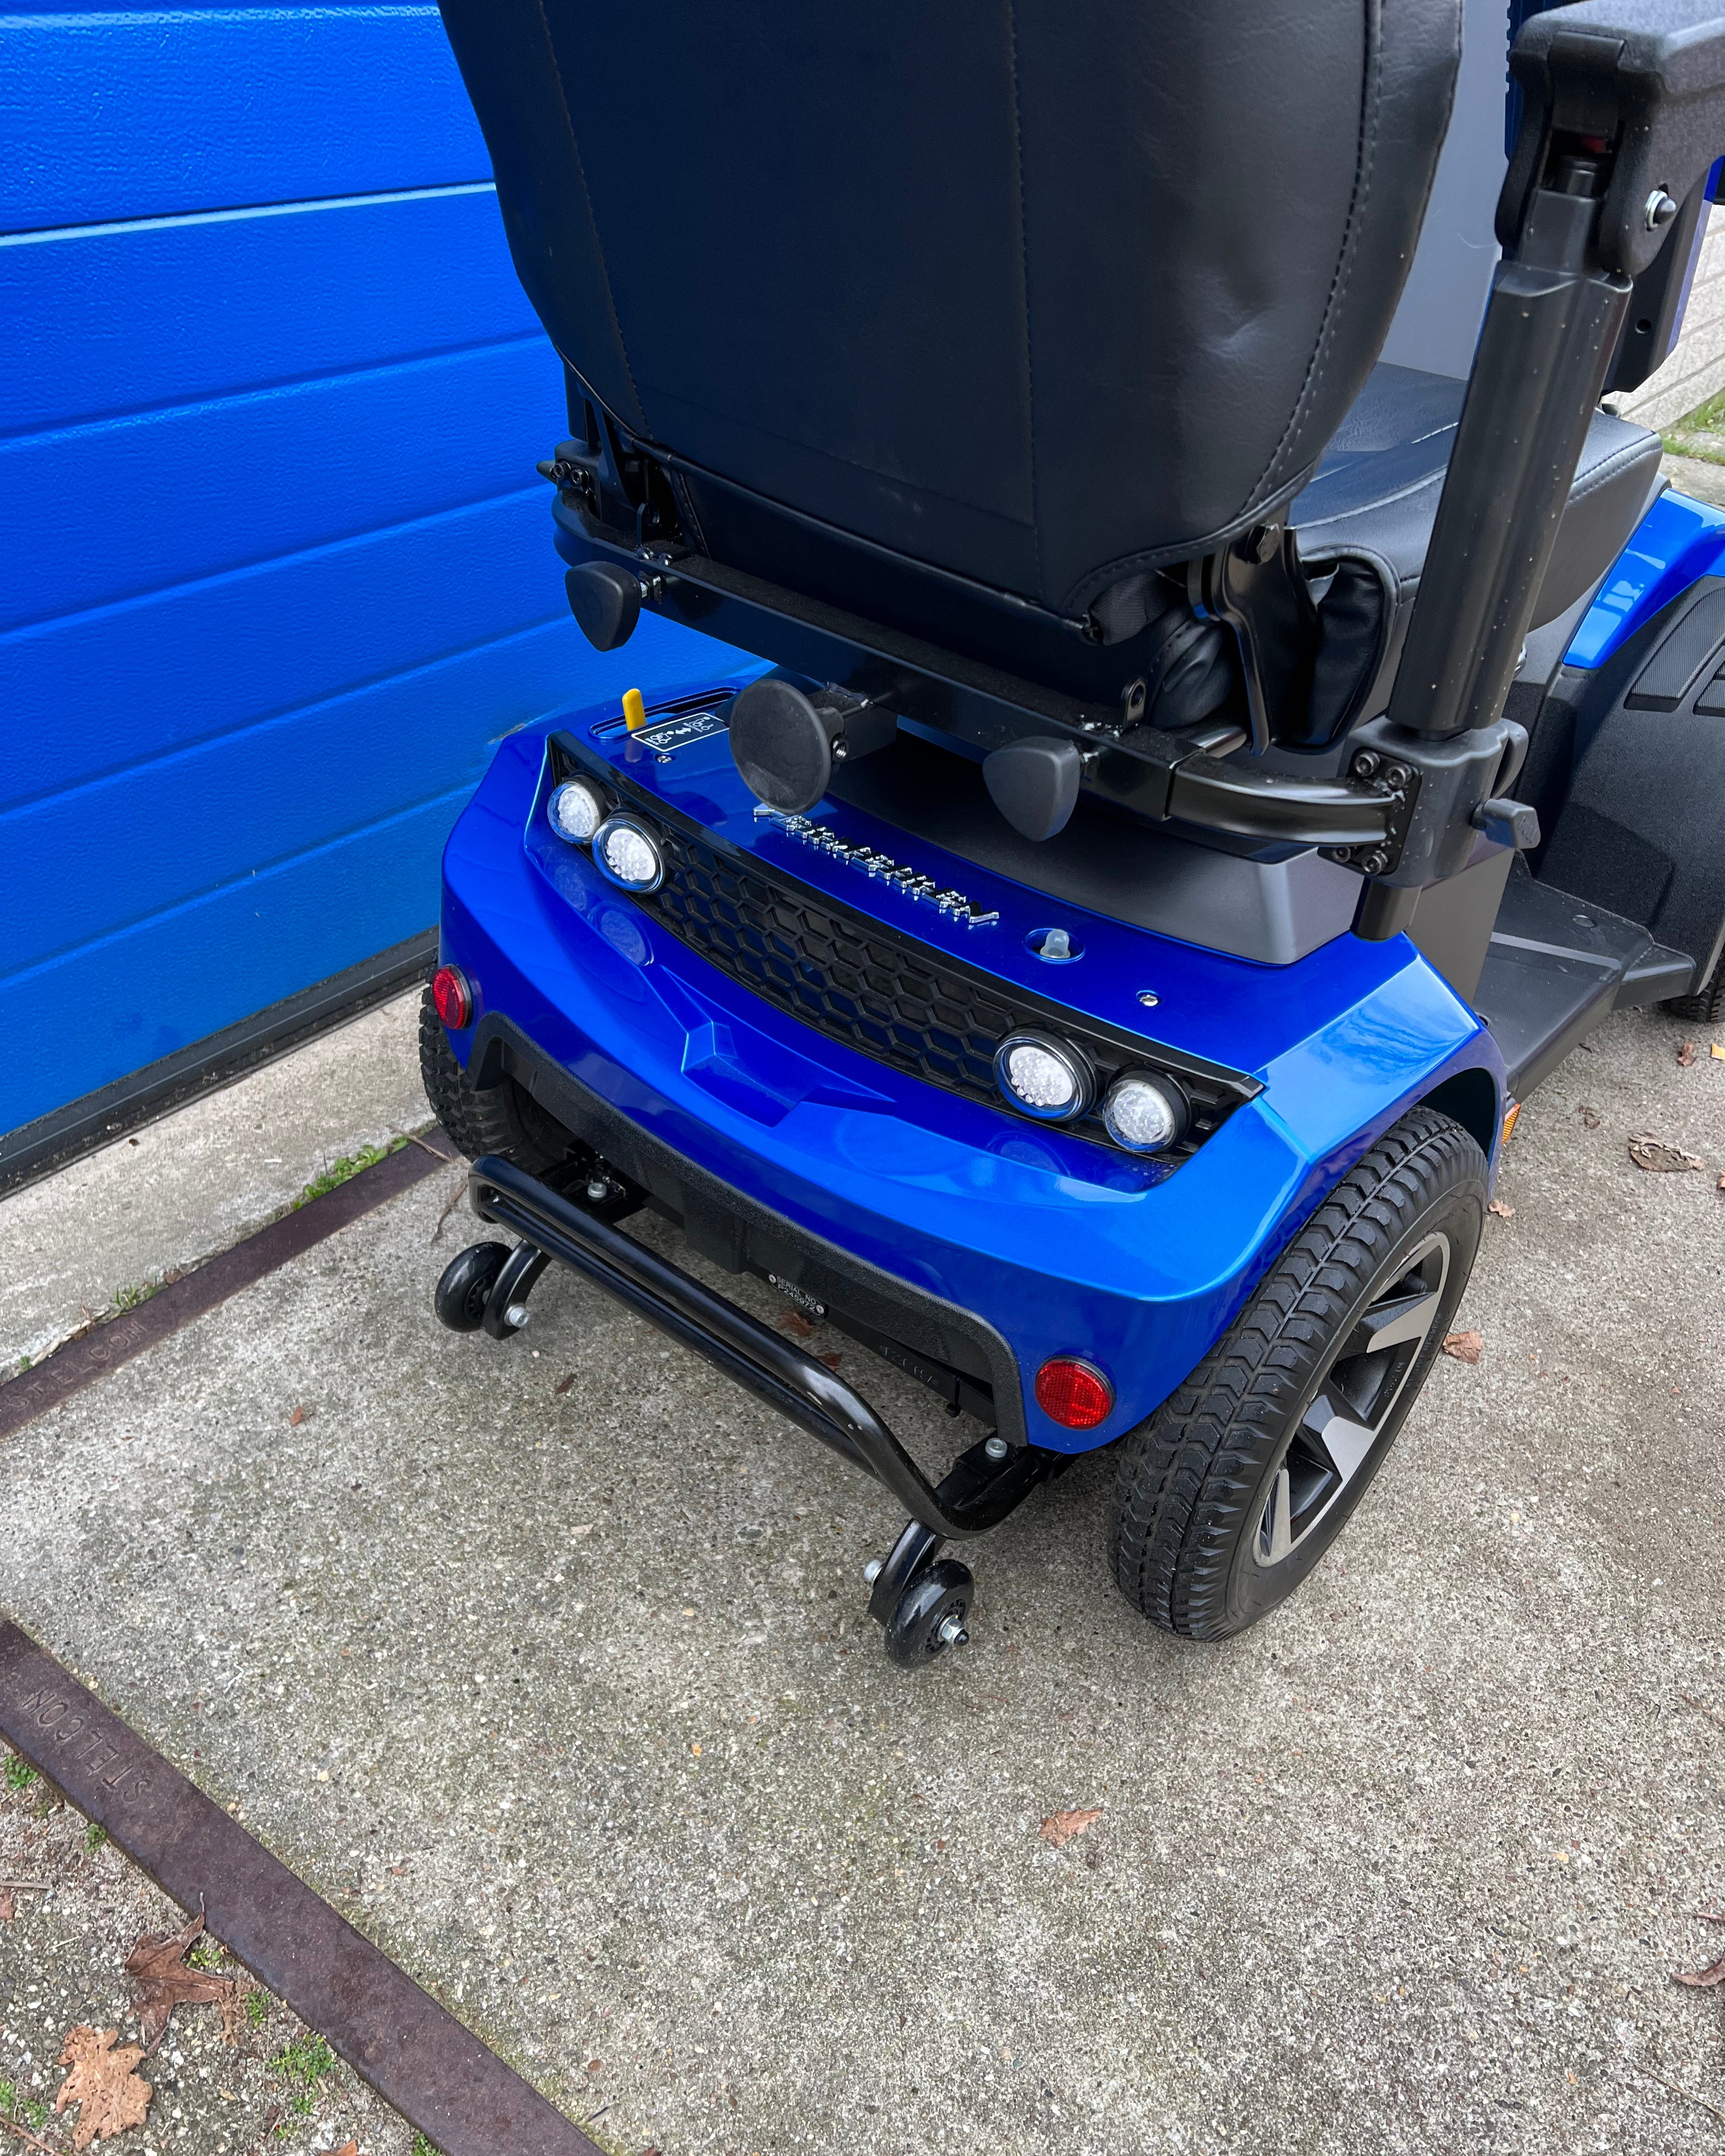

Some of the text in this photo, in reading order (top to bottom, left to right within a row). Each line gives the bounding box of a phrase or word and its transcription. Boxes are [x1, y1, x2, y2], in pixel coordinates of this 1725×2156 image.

[776, 1276, 801, 1296] SERIAL
[778, 1283, 816, 1312] P245972
[6, 1321, 147, 1410] STELCON
[21, 1688, 152, 1803] STELCON
